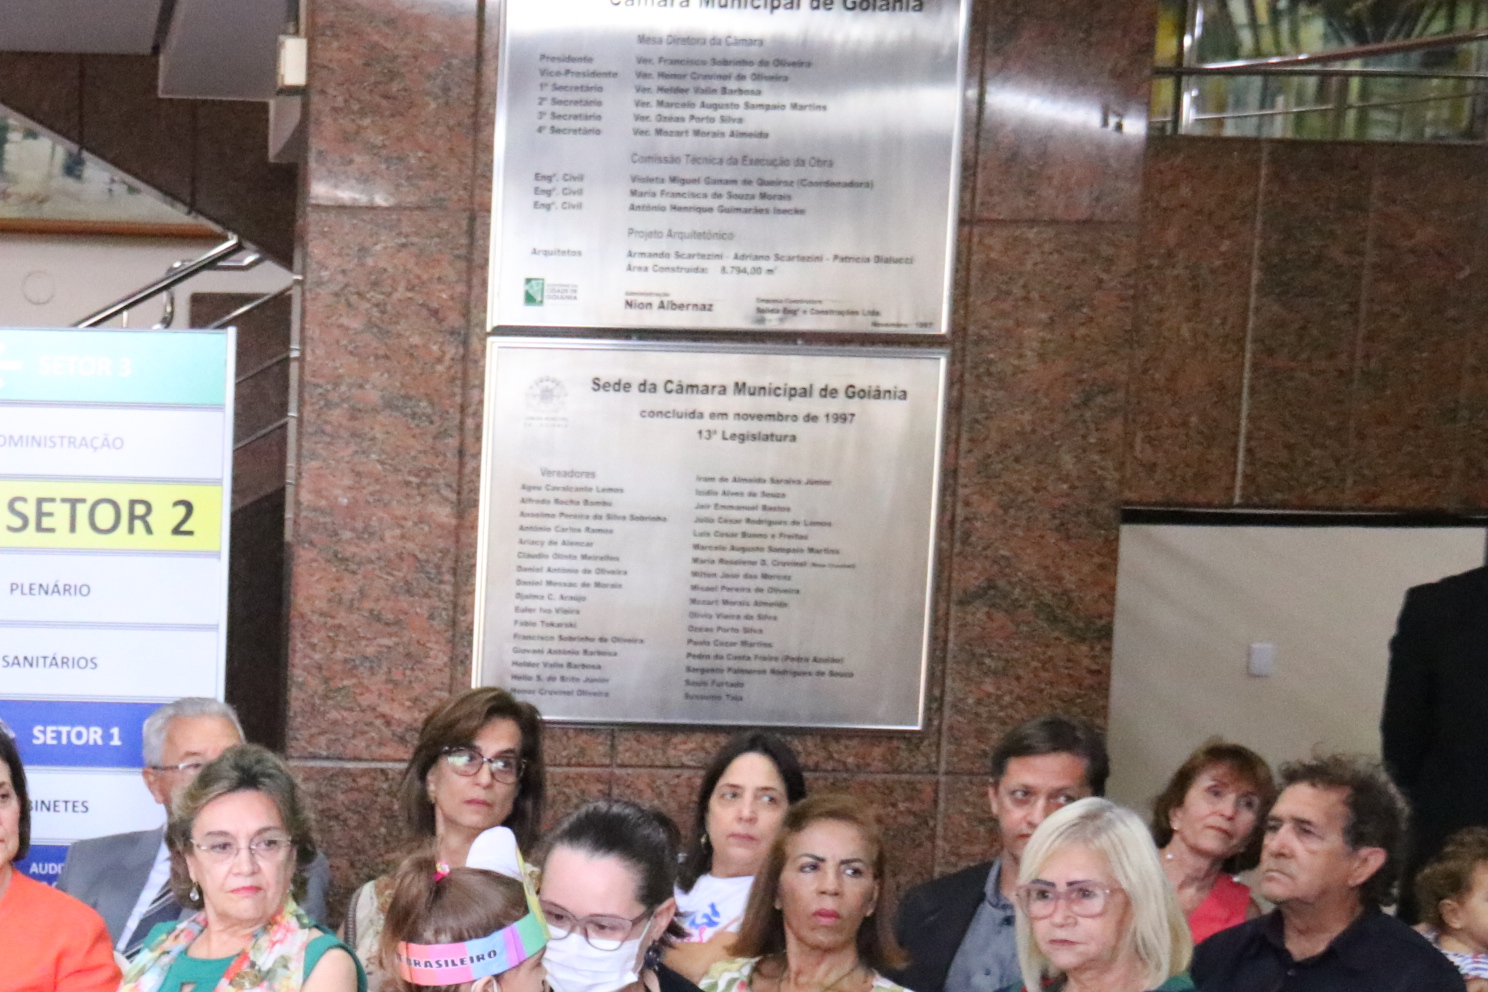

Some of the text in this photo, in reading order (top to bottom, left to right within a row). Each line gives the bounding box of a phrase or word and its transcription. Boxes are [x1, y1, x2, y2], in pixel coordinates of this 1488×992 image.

[39, 355, 132, 378] SETOR 3
[592, 377, 907, 400] Sede da Câmara Municipal de Goiânia
[709, 412, 729, 420] em
[734, 413, 799, 422] novembro
[803, 413, 819, 423] de
[825, 413, 855, 424] 1997
[722, 432, 797, 443] Legislatura
[5, 495, 195, 537] SETOR 2
[9, 579, 92, 598] PLENÁRIO
[1, 651, 99, 671] SANITÁRIOS
[32, 724, 122, 746] SETOR 1
[406, 949, 498, 969] BRASILEIRO
